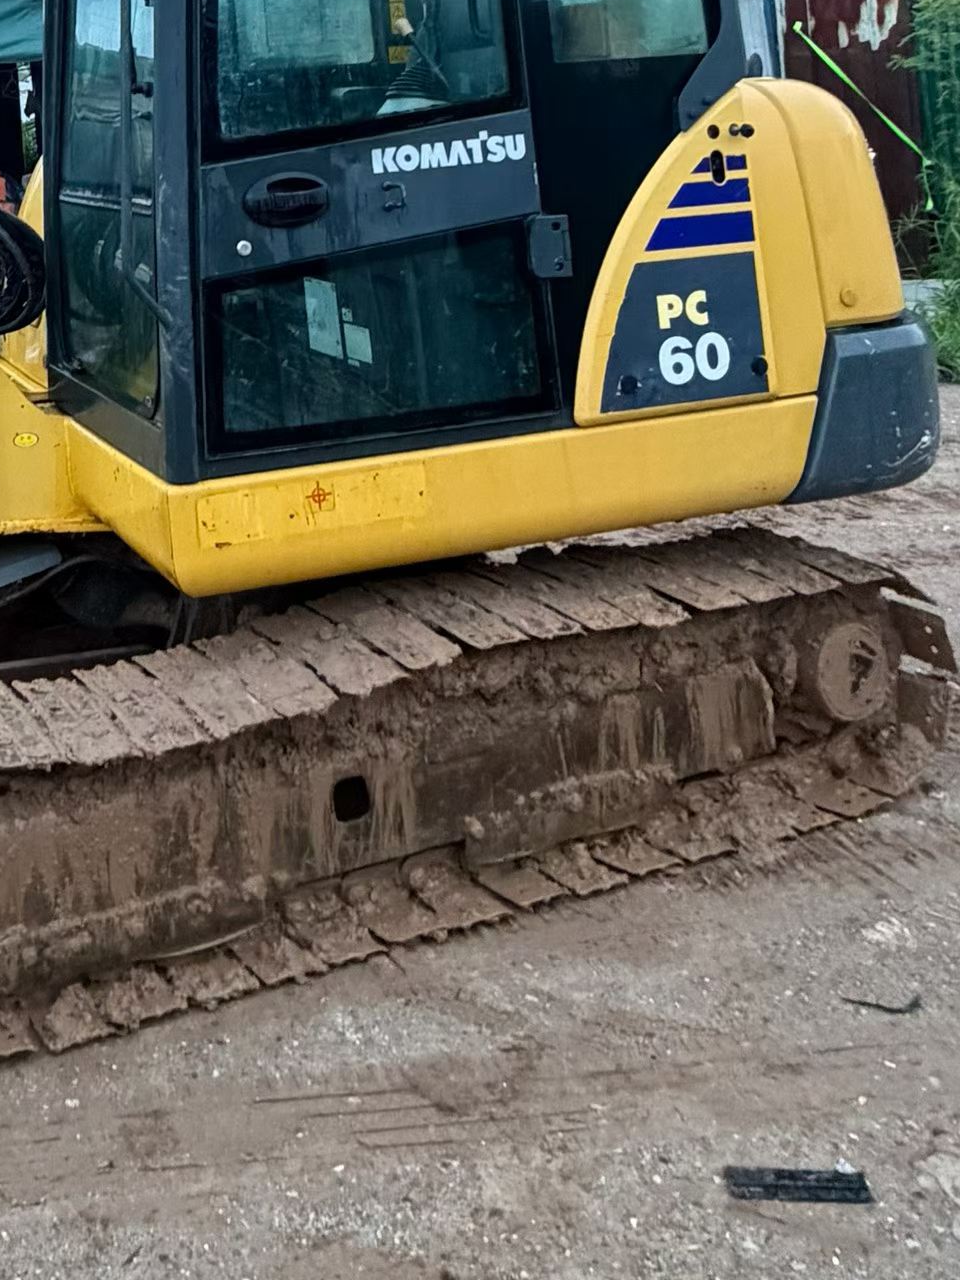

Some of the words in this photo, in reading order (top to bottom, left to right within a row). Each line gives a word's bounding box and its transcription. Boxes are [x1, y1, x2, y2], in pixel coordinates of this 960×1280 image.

[371, 130, 527, 174] KOMATSU
[655, 289, 709, 330] PC
[658, 331, 731, 386] 60
